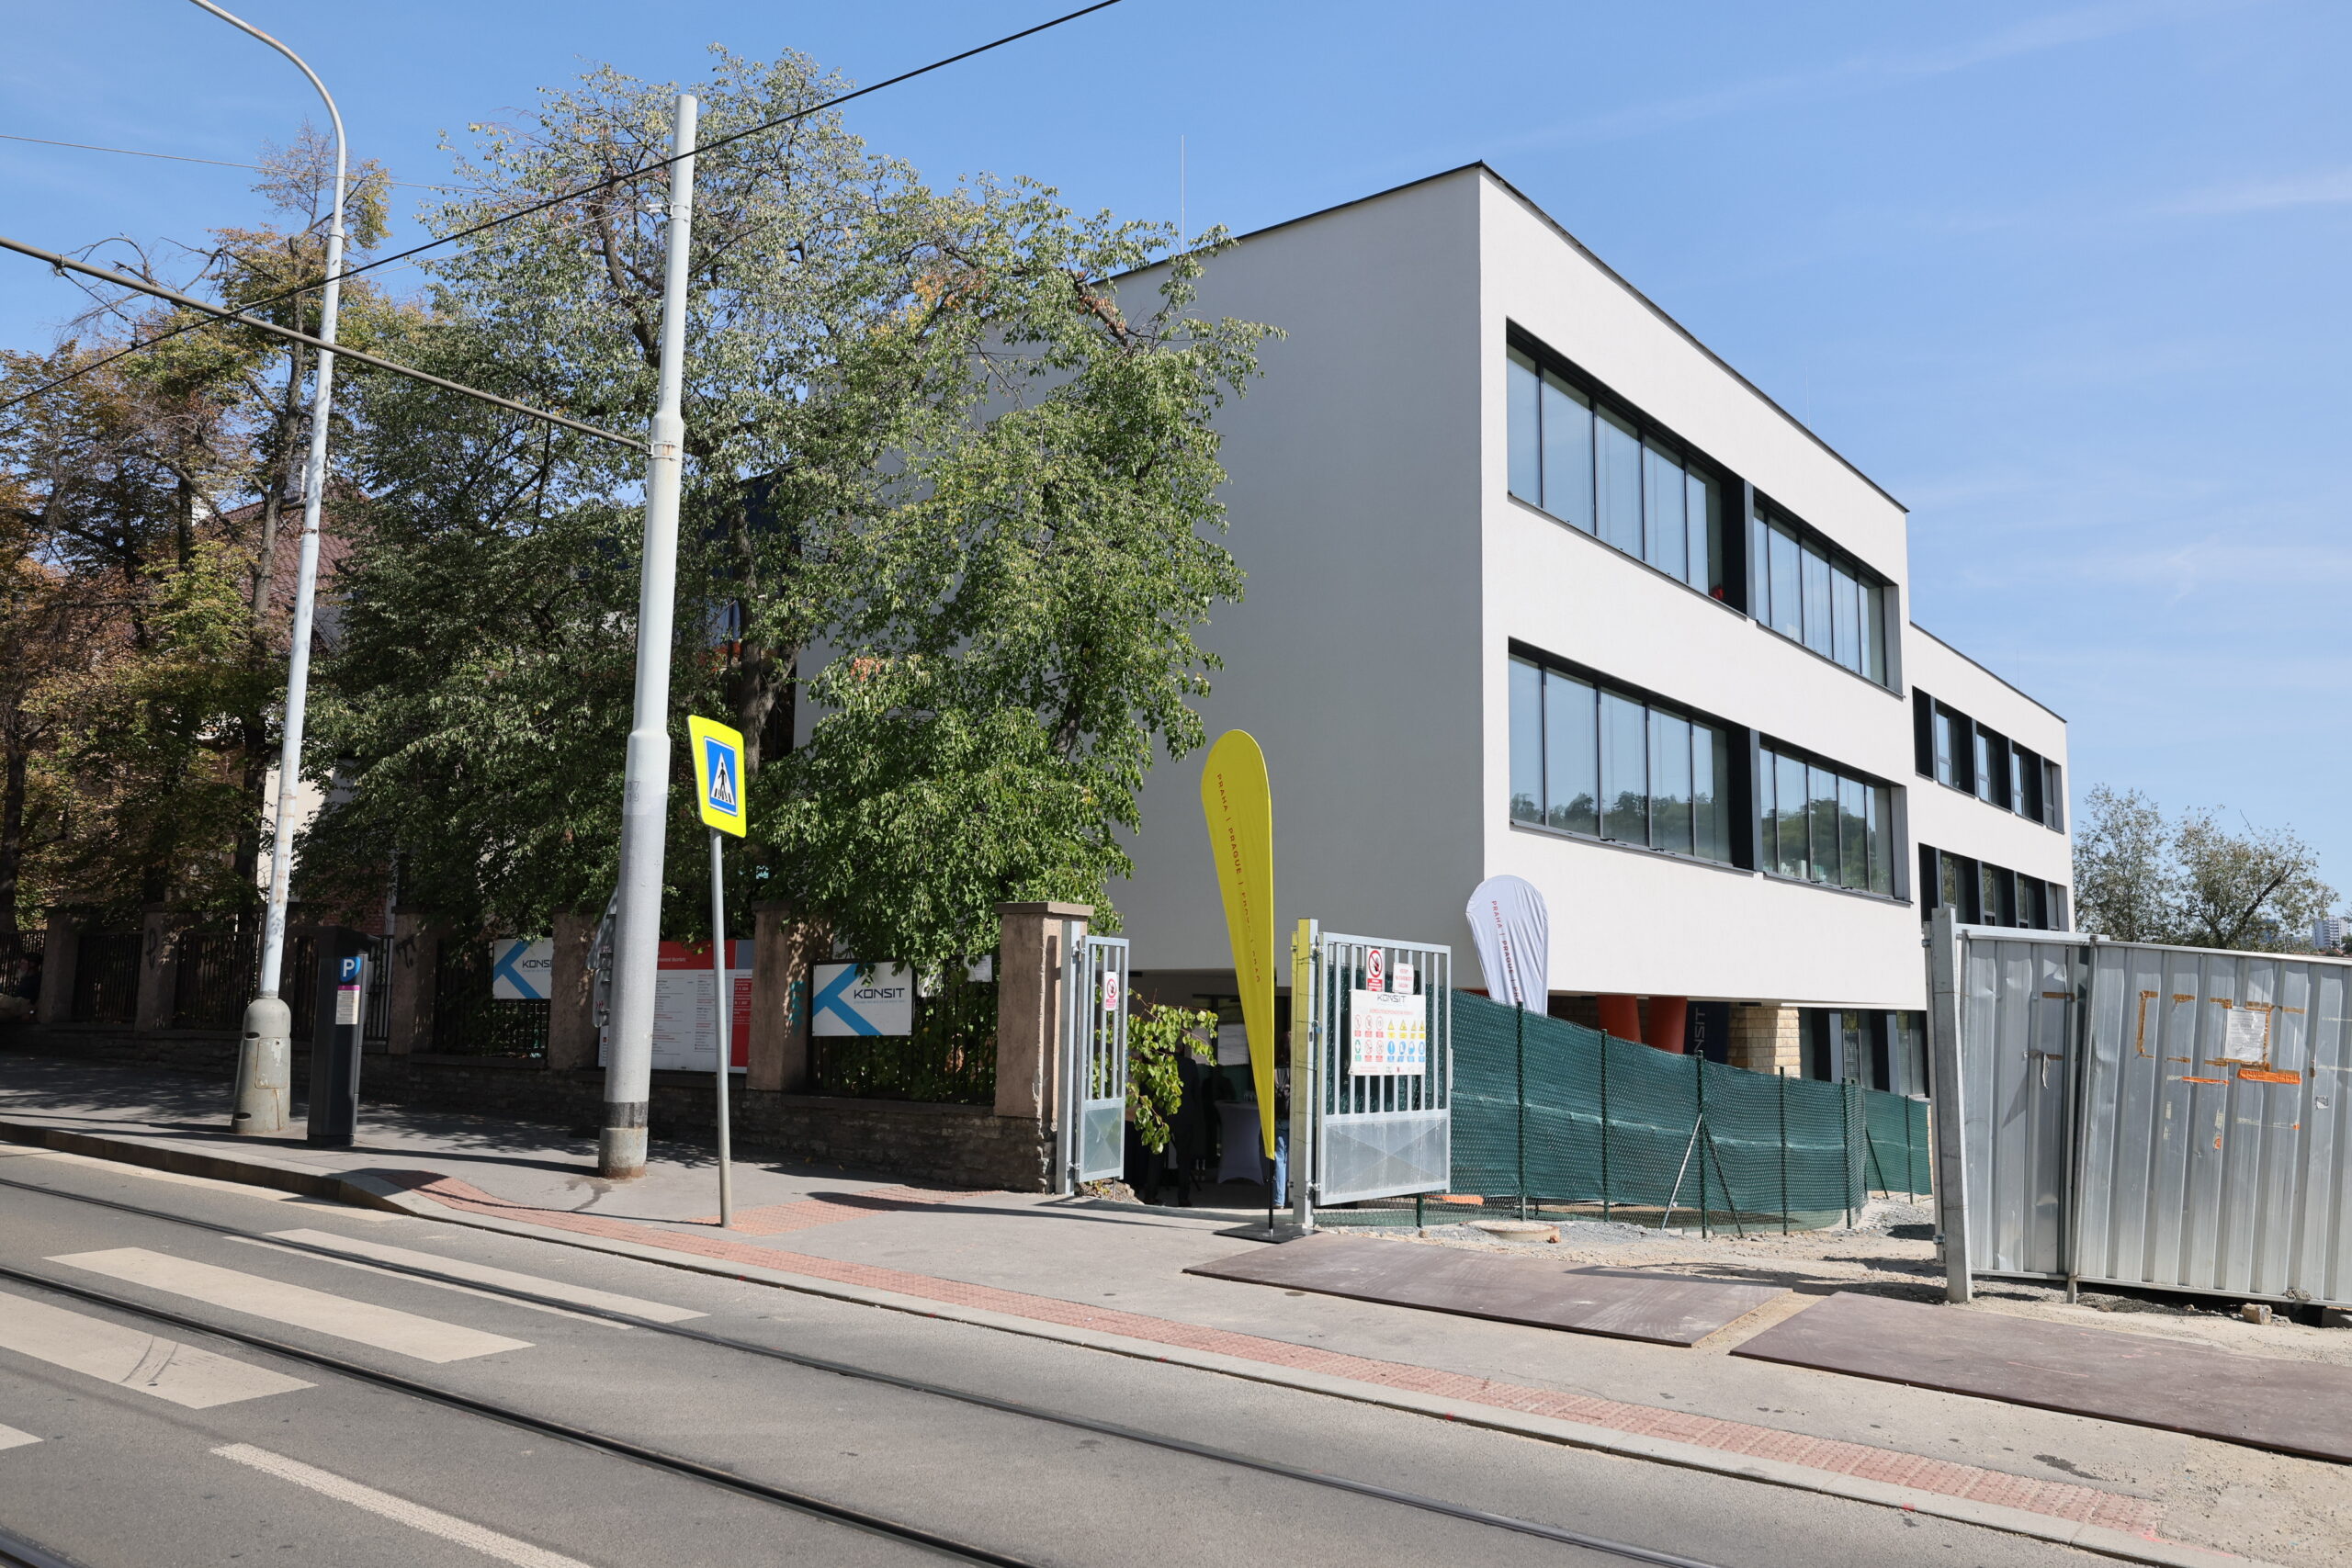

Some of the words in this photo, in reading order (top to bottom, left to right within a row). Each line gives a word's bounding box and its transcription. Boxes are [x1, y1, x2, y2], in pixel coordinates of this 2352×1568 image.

[1216, 773, 1228, 812] PRAHA
[1227, 828, 1242, 874] PRAGUE
[1491, 900, 1503, 929] PRAHA
[1501, 940, 1514, 974] PRAGUE
[343, 958, 356, 977] P
[522, 959, 552, 969] KONSI
[854, 987, 906, 999] KONSIT
[1377, 994, 1407, 1003] KONSIT
[1693, 1007, 1706, 1055] NSIT
